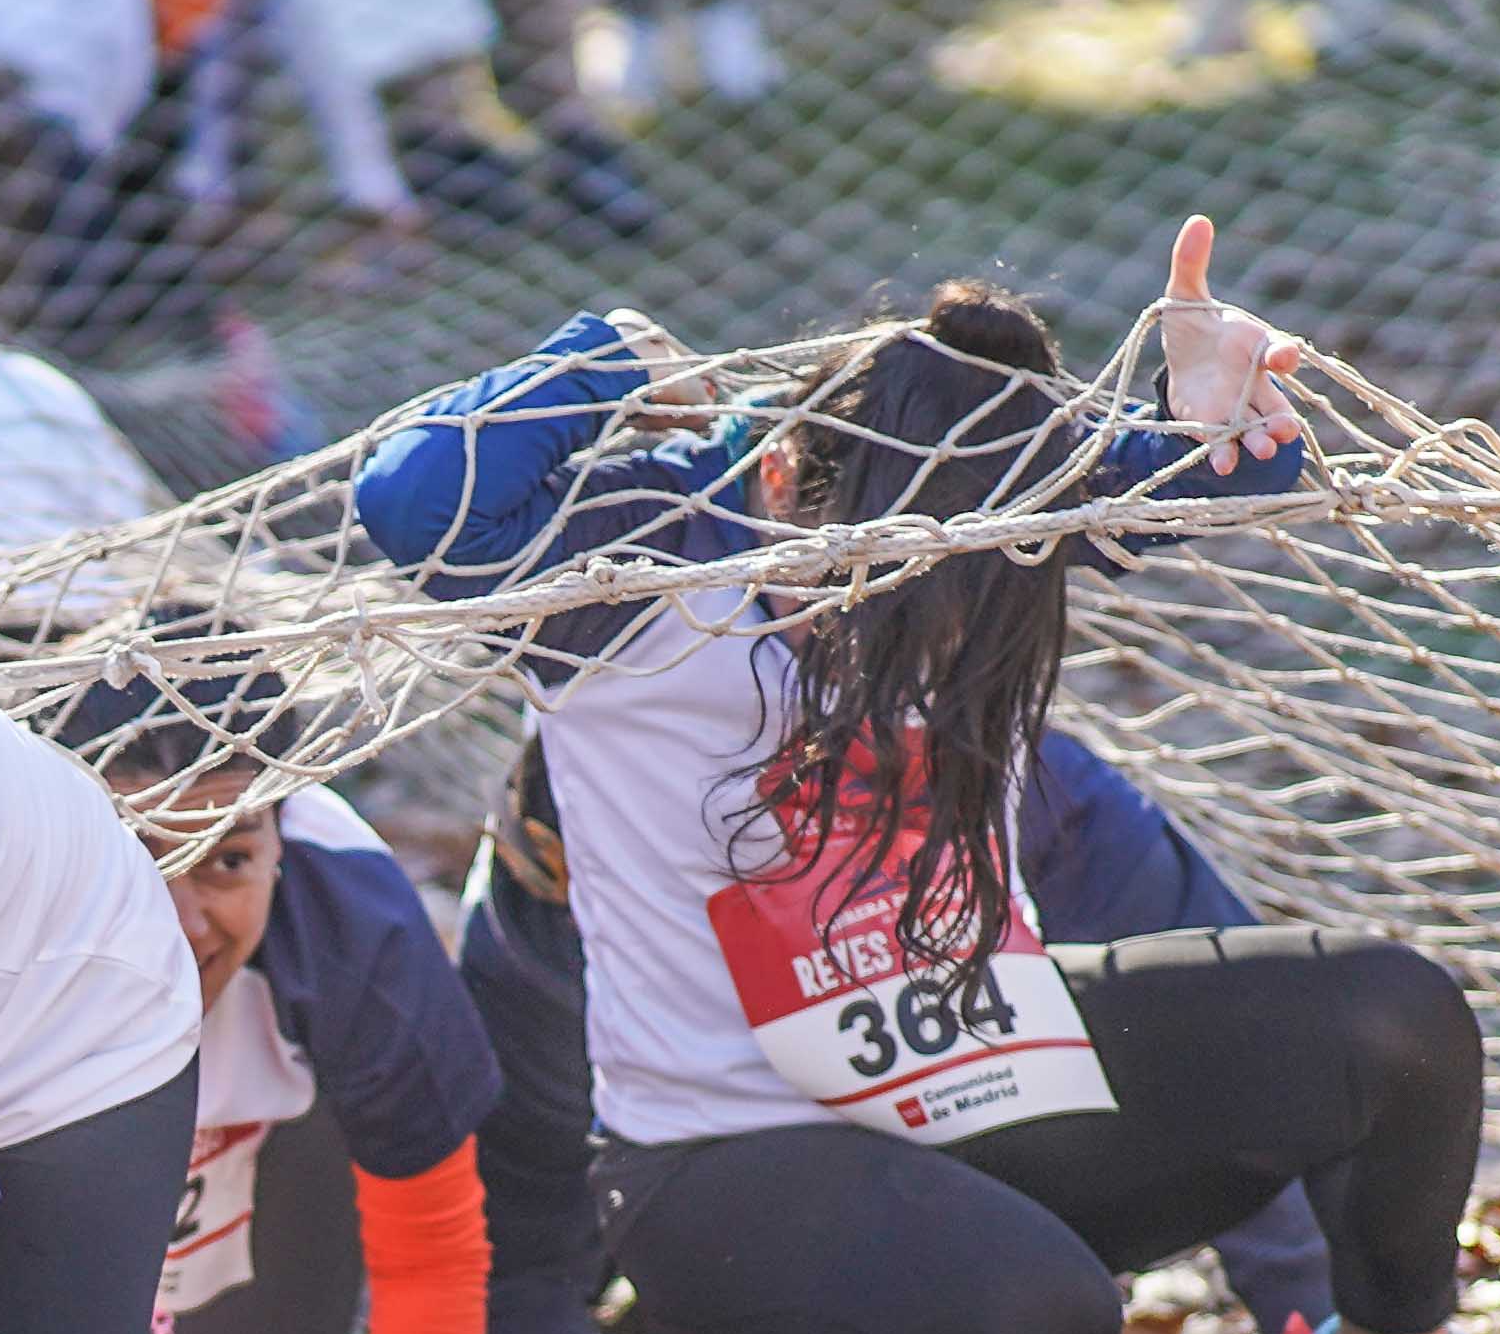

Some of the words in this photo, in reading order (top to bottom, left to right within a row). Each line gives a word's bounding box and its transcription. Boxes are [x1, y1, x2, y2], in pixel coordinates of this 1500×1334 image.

[791, 930, 893, 999] REYES
[839, 960, 1016, 1078] 364
[954, 1083, 1018, 1112] Madrid
